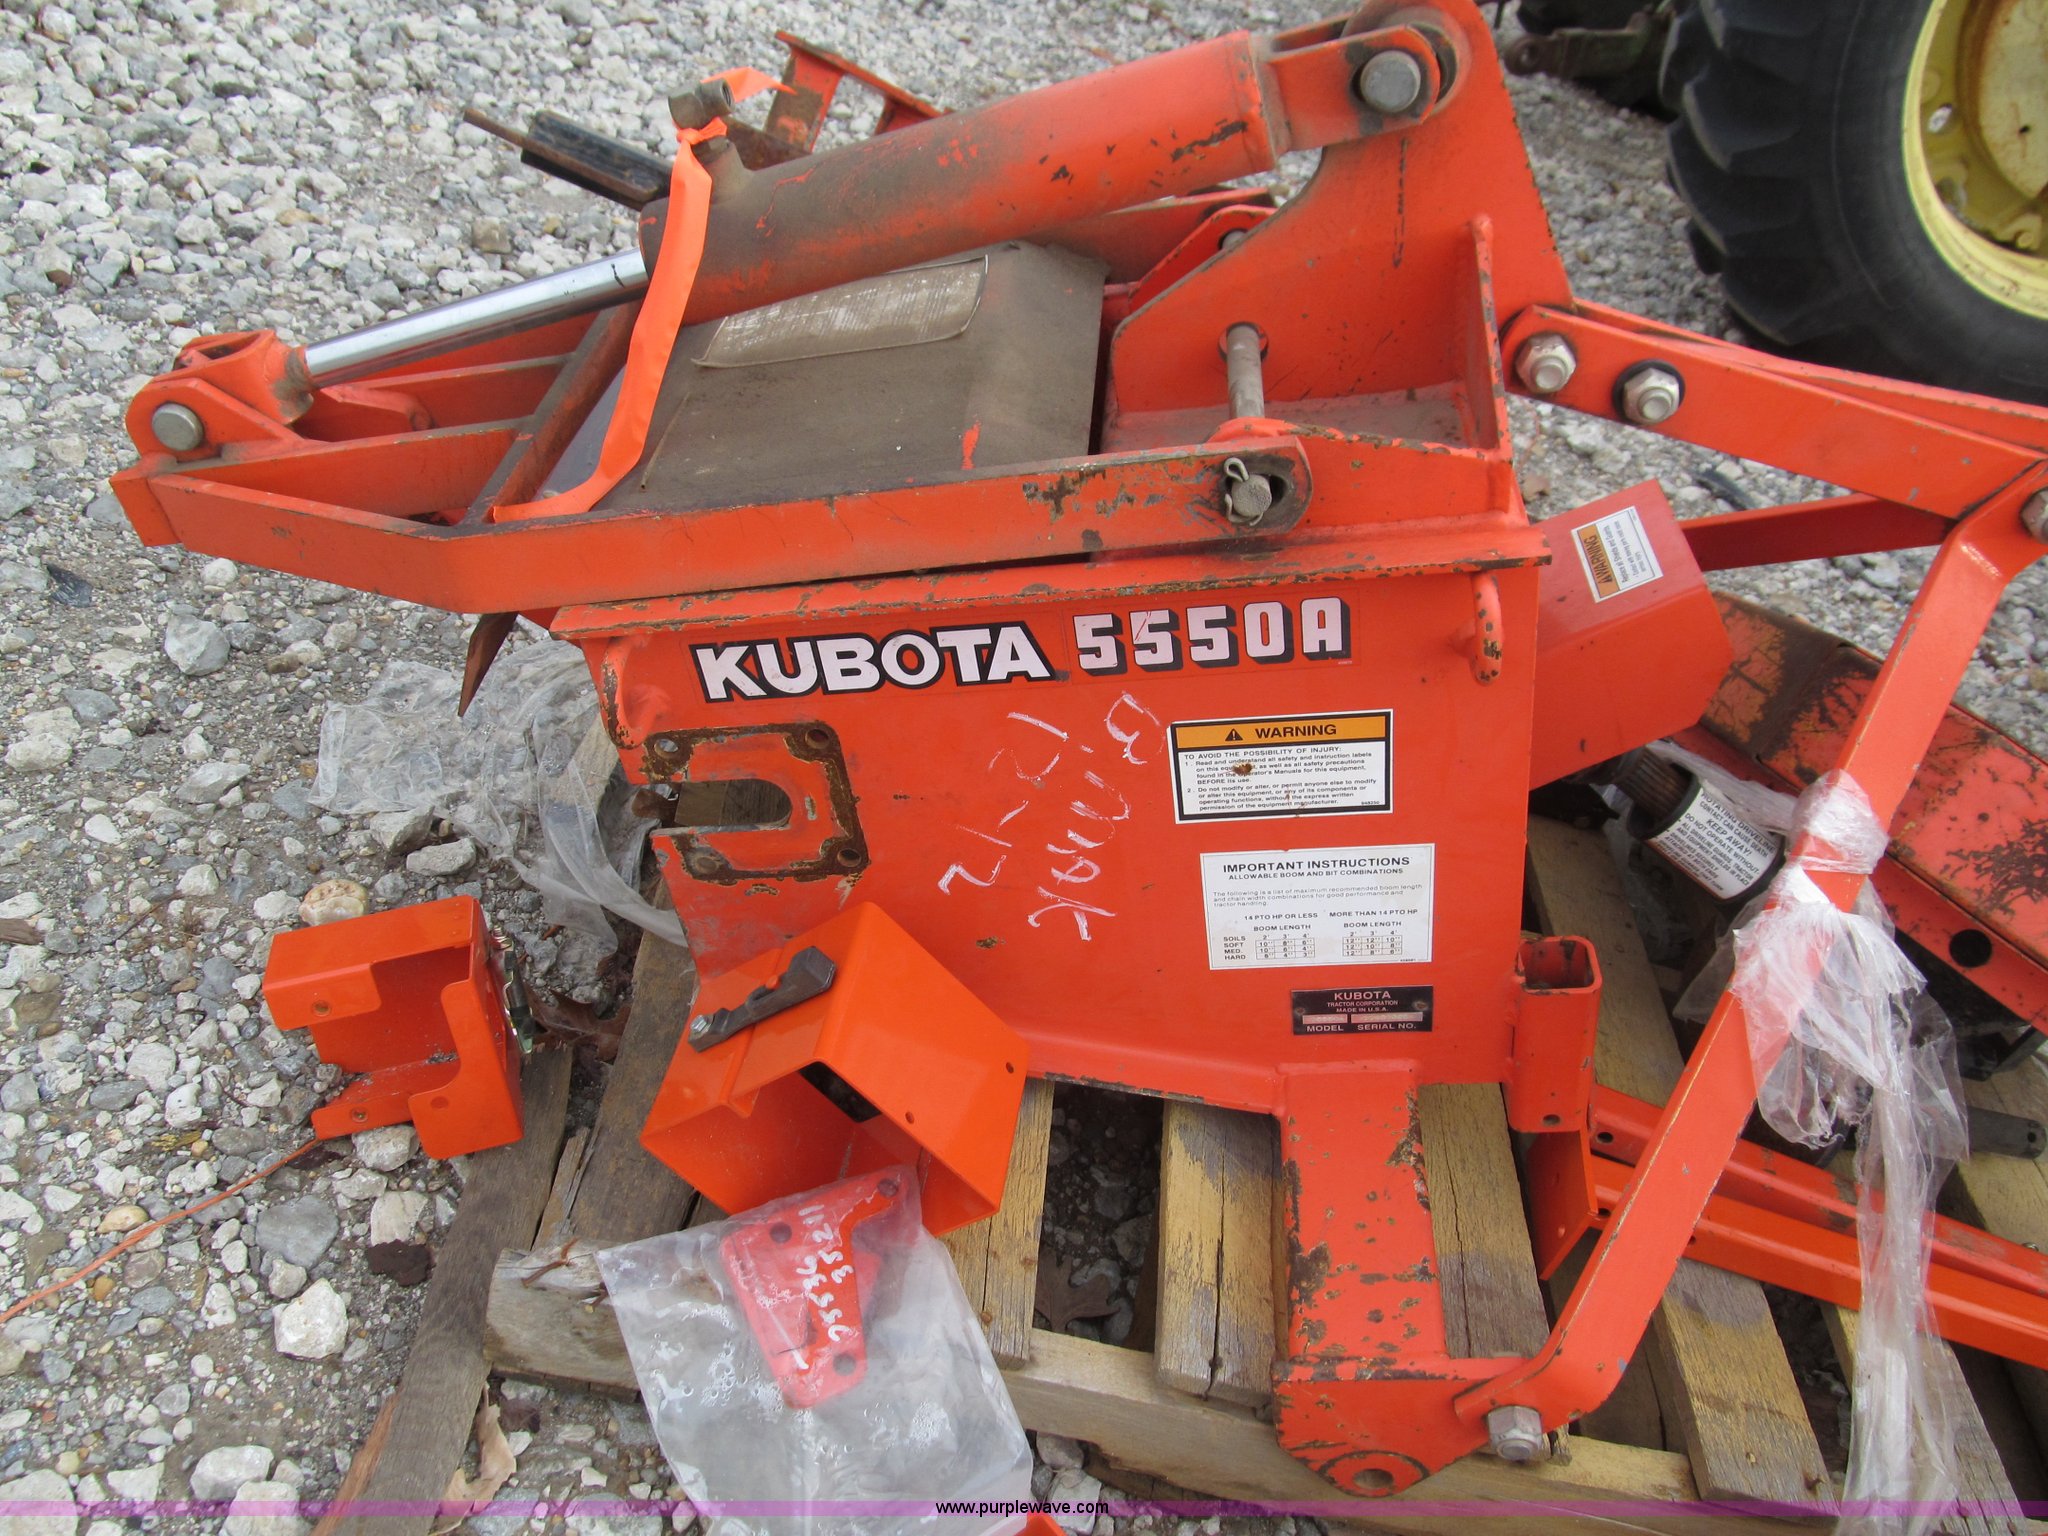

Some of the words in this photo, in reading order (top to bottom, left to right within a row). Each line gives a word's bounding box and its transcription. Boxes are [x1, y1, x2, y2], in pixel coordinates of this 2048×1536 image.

[690, 622, 1055, 702] KUBOTA
[1072, 597, 1349, 674] 5550A
[1255, 724, 1337, 739] WARNING
[1243, 748, 1292, 757] POSSIBILITY
[1685, 812, 1695, 822] DO
[1694, 821, 1707, 832] NOT
[1706, 831, 1732, 854] OPERATE
[1706, 818, 1727, 836] KEEP
[1223, 861, 1304, 873] IMPORTANT
[1307, 856, 1410, 869] INSTRUCTIONS
[1229, 872, 1278, 880] ALLOWABLE
[1339, 868, 1404, 876] COMBINATIONS
[1334, 991, 1391, 1001] KUBOTA
[1306, 1024, 1344, 1032] MODEL
[1357, 1023, 1395, 1031] SERIAL
